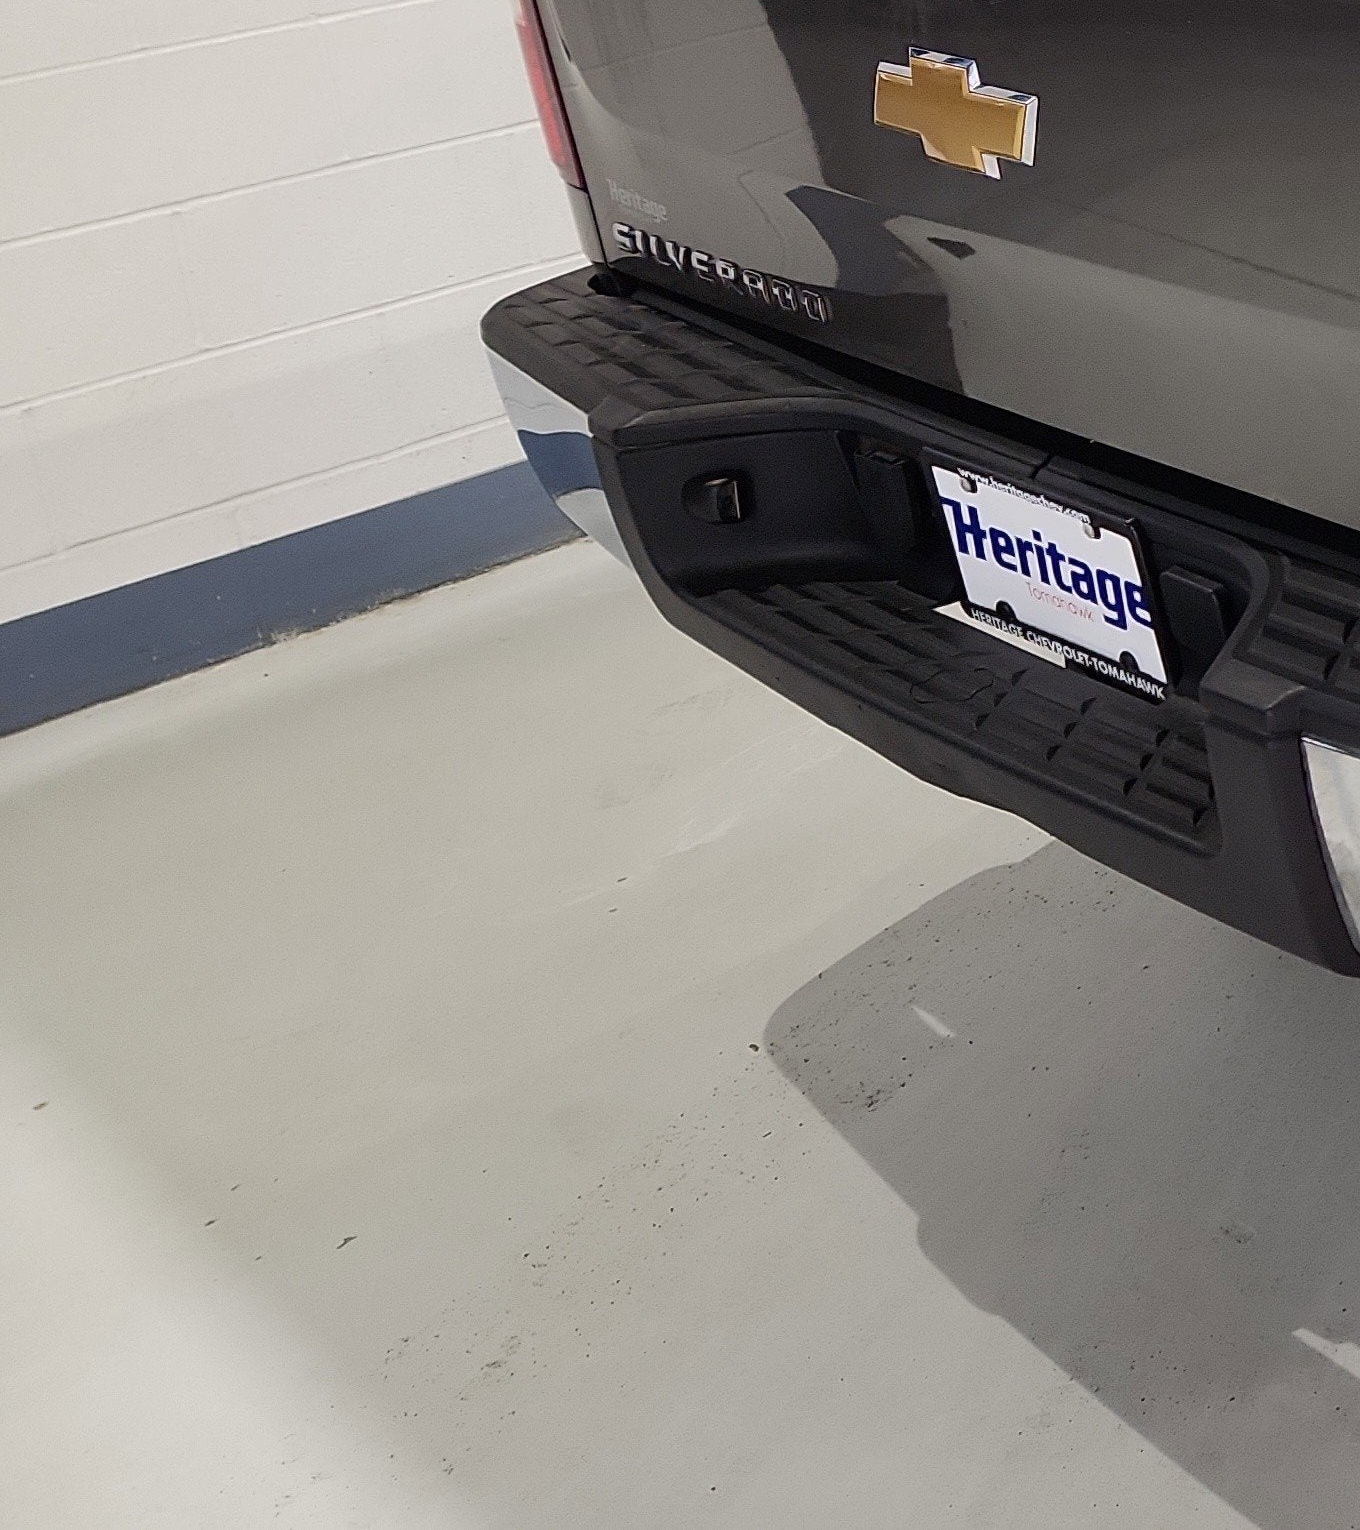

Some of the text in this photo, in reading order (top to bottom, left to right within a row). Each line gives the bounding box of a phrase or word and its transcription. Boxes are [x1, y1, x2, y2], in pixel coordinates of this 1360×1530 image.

[612, 222, 829, 324] SILVERADO
[939, 496, 1152, 631] Heritage
[1025, 581, 1095, 623] Tomahawk
[970, 607, 1167, 702] HERITAGE CHEVROLET-TOMAHAWK
